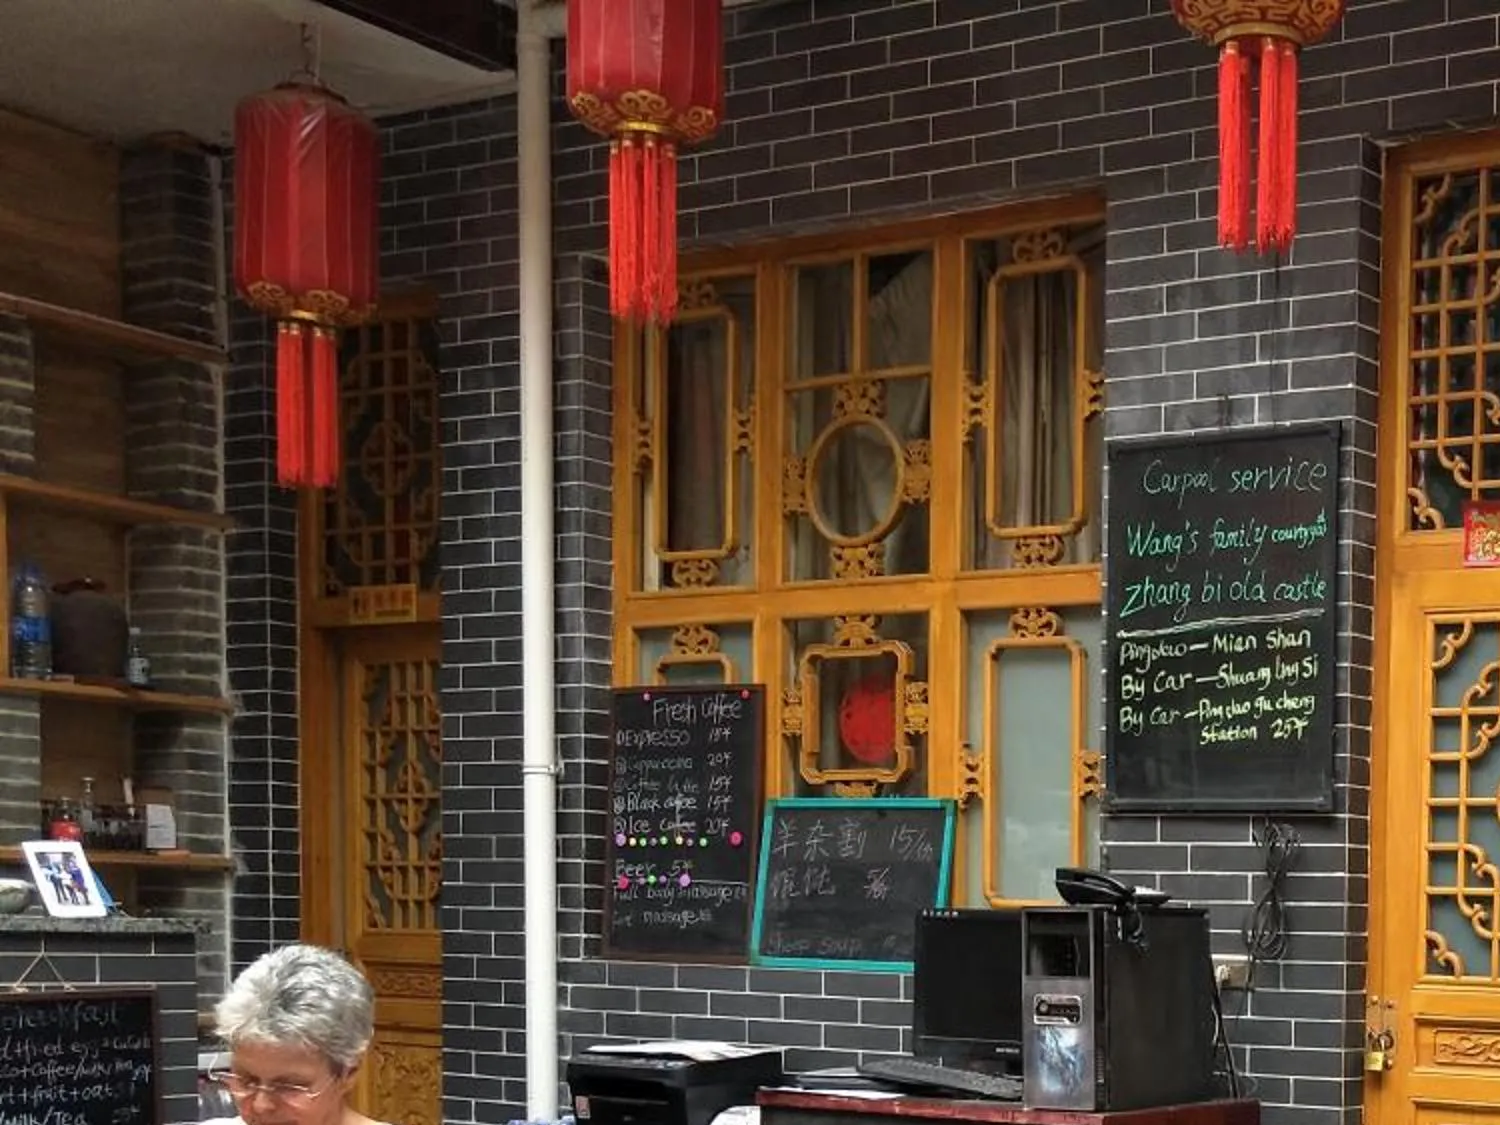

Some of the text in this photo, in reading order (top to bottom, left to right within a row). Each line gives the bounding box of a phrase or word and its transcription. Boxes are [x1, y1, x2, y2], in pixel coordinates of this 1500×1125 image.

[1230, 456, 1328, 493] service
[1126, 520, 1199, 573] Wang's
[1209, 517, 1268, 566] family
[1201, 568, 1223, 604] bi
[1229, 568, 1267, 603] old
[1273, 568, 1327, 603] castle
[1120, 674, 1146, 702] By
[1153, 669, 1193, 694] Car
[653, 695, 697, 726] Fresh
[1119, 705, 1146, 737] By
